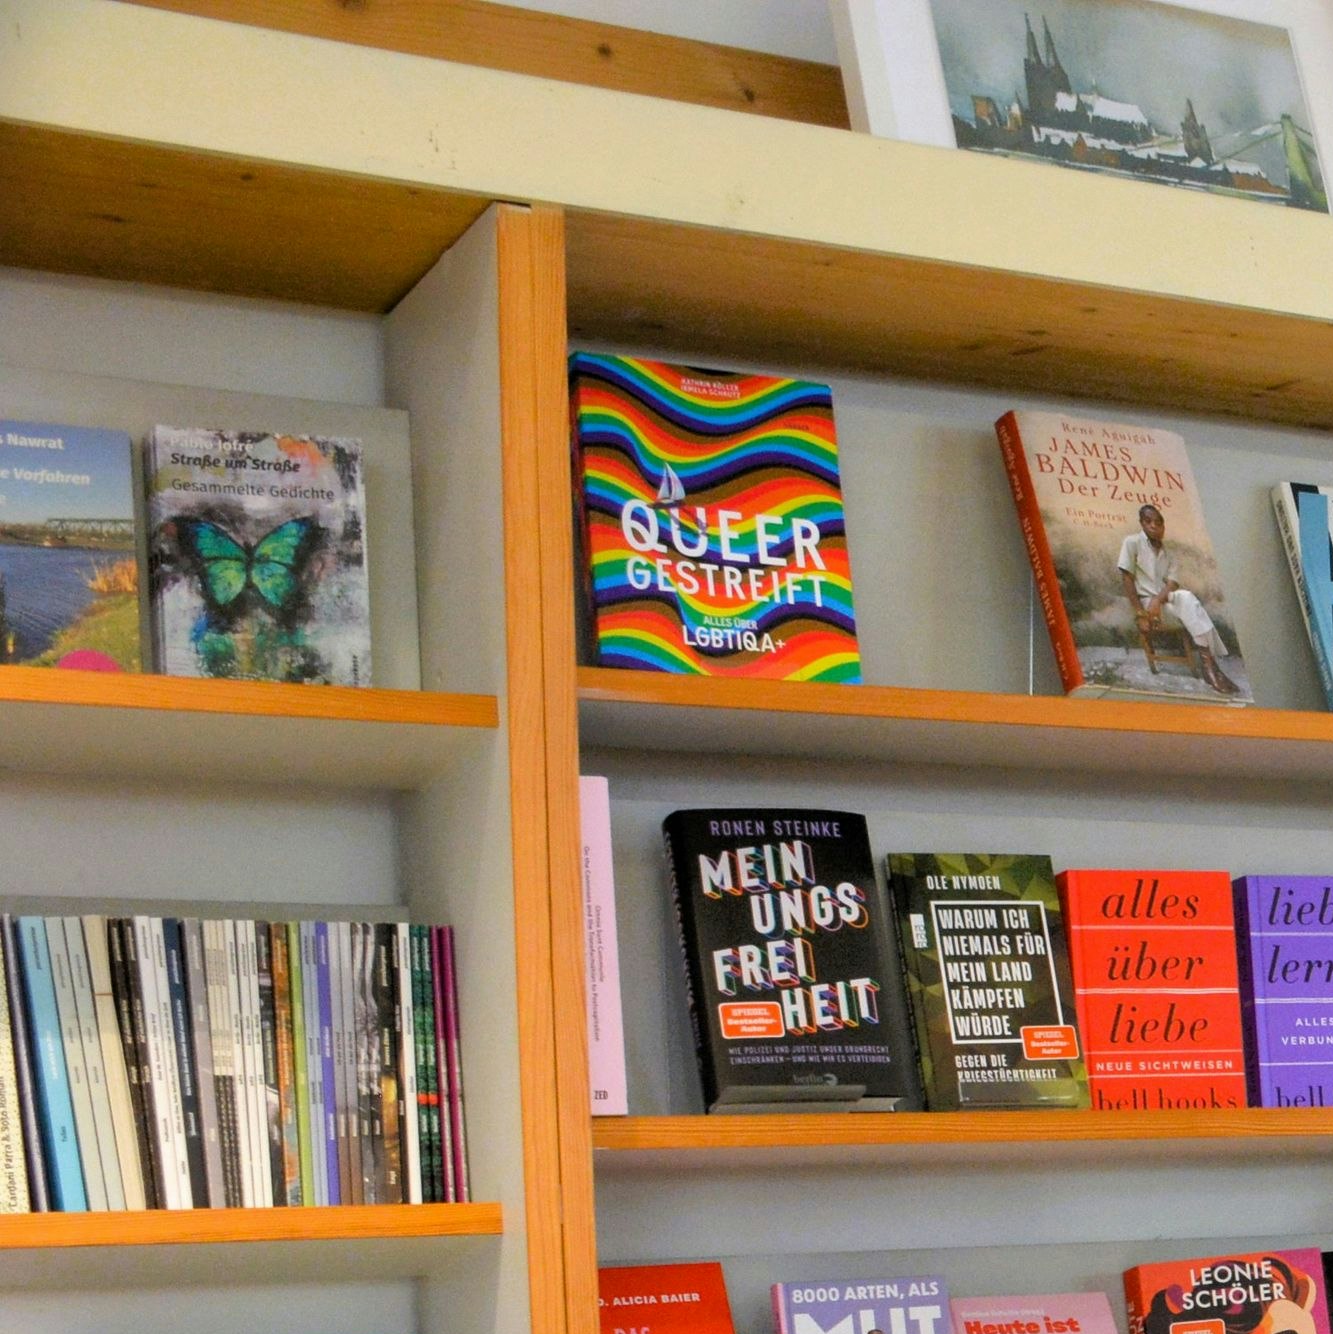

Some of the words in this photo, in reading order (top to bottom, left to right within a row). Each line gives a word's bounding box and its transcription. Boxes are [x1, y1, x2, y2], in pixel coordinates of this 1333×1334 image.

[7, 434, 64, 450] Nawrat
[1048, 436, 1133, 464] JAMES
[13, 469, 90, 485] Vorfahren
[1034, 453, 1186, 493] BALDWIN
[172, 478, 264, 497] Gesammelte
[269, 484, 335, 500] Gedichte
[1057, 478, 1102, 498] Der
[1109, 484, 1172, 510] Zeuge
[620, 499, 825, 570] QUEER
[626, 558, 827, 608] GESTREIFT
[681, 625, 786, 654] LGBTIQA+
[709, 820, 766, 836] RONEN
[773, 821, 841, 838] STEINKE
[699, 840, 814, 898] MEIN
[927, 876, 948, 890] OLE
[952, 876, 1001, 890] NYMOEN
[750, 882, 866, 935] UNGS
[1102, 879, 1199, 919] alles
[938, 909, 998, 930] WARUM
[1002, 910, 1029, 929] ICH
[942, 936, 1011, 956] NIEMALS
[1016, 933, 1046, 956] FÜR
[713, 938, 812, 994] FREI
[947, 962, 988, 983] MEIN
[994, 962, 1032, 982] LAND
[1108, 941, 1204, 982] über
[782, 977, 880, 1032] HEIT
[951, 986, 1025, 1010] KÄMPFEN
[956, 1013, 1012, 1038] WÜRDE
[1110, 1003, 1208, 1044] liebe
[1189, 1261, 1273, 1286] LEONIE
[613, 1295, 658, 1306] ALICIA
[661, 1292, 701, 1304] BAIER
[1182, 1282, 1286, 1311] SCHÖLER
[1045, 1316, 1080, 1334] ist
